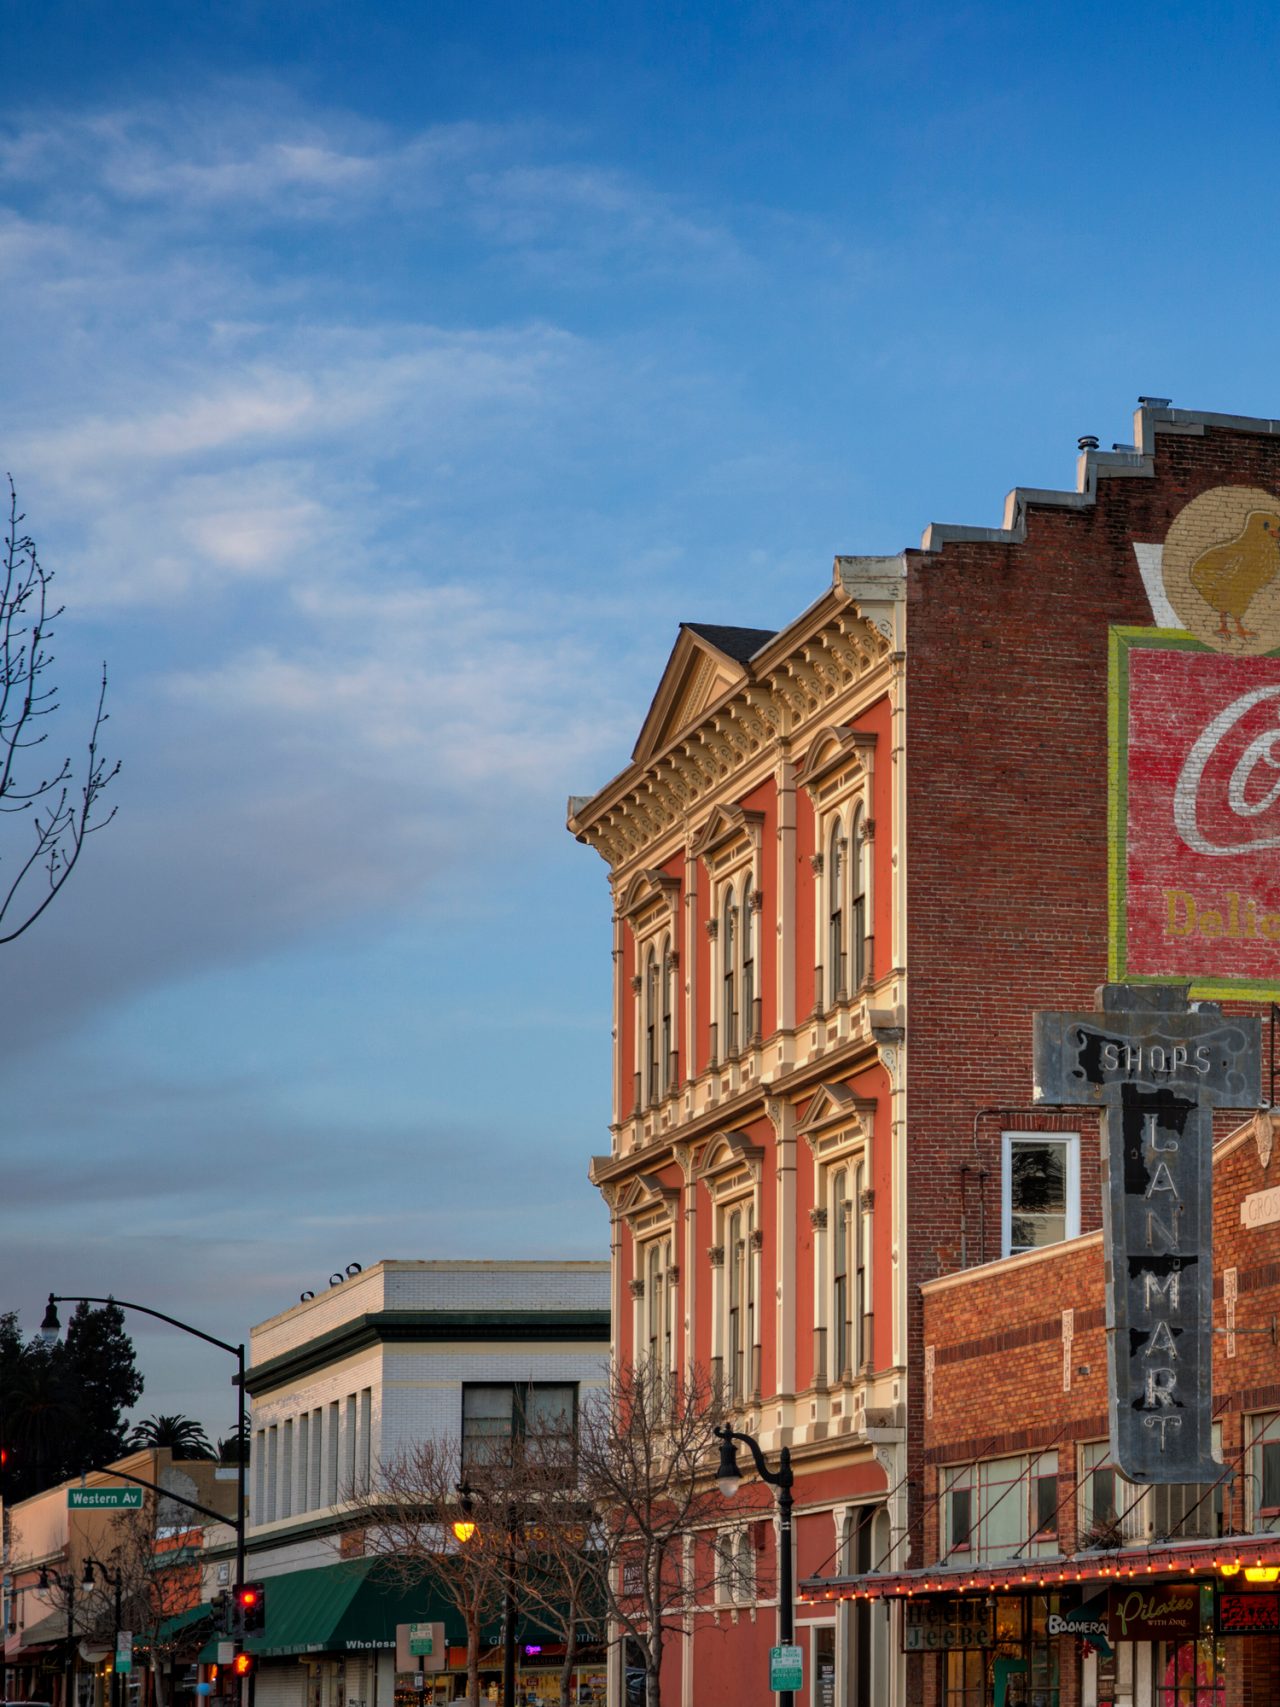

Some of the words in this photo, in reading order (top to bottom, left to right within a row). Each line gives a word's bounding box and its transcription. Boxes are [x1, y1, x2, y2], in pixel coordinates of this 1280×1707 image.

[1103, 1044, 1211, 1074] SHOPS
[72, 1492, 118, 1504] Western
[122, 1492, 138, 1504] Av
[1115, 1591, 1194, 1636] Pilates
[1147, 1619, 1167, 1627] WITH
